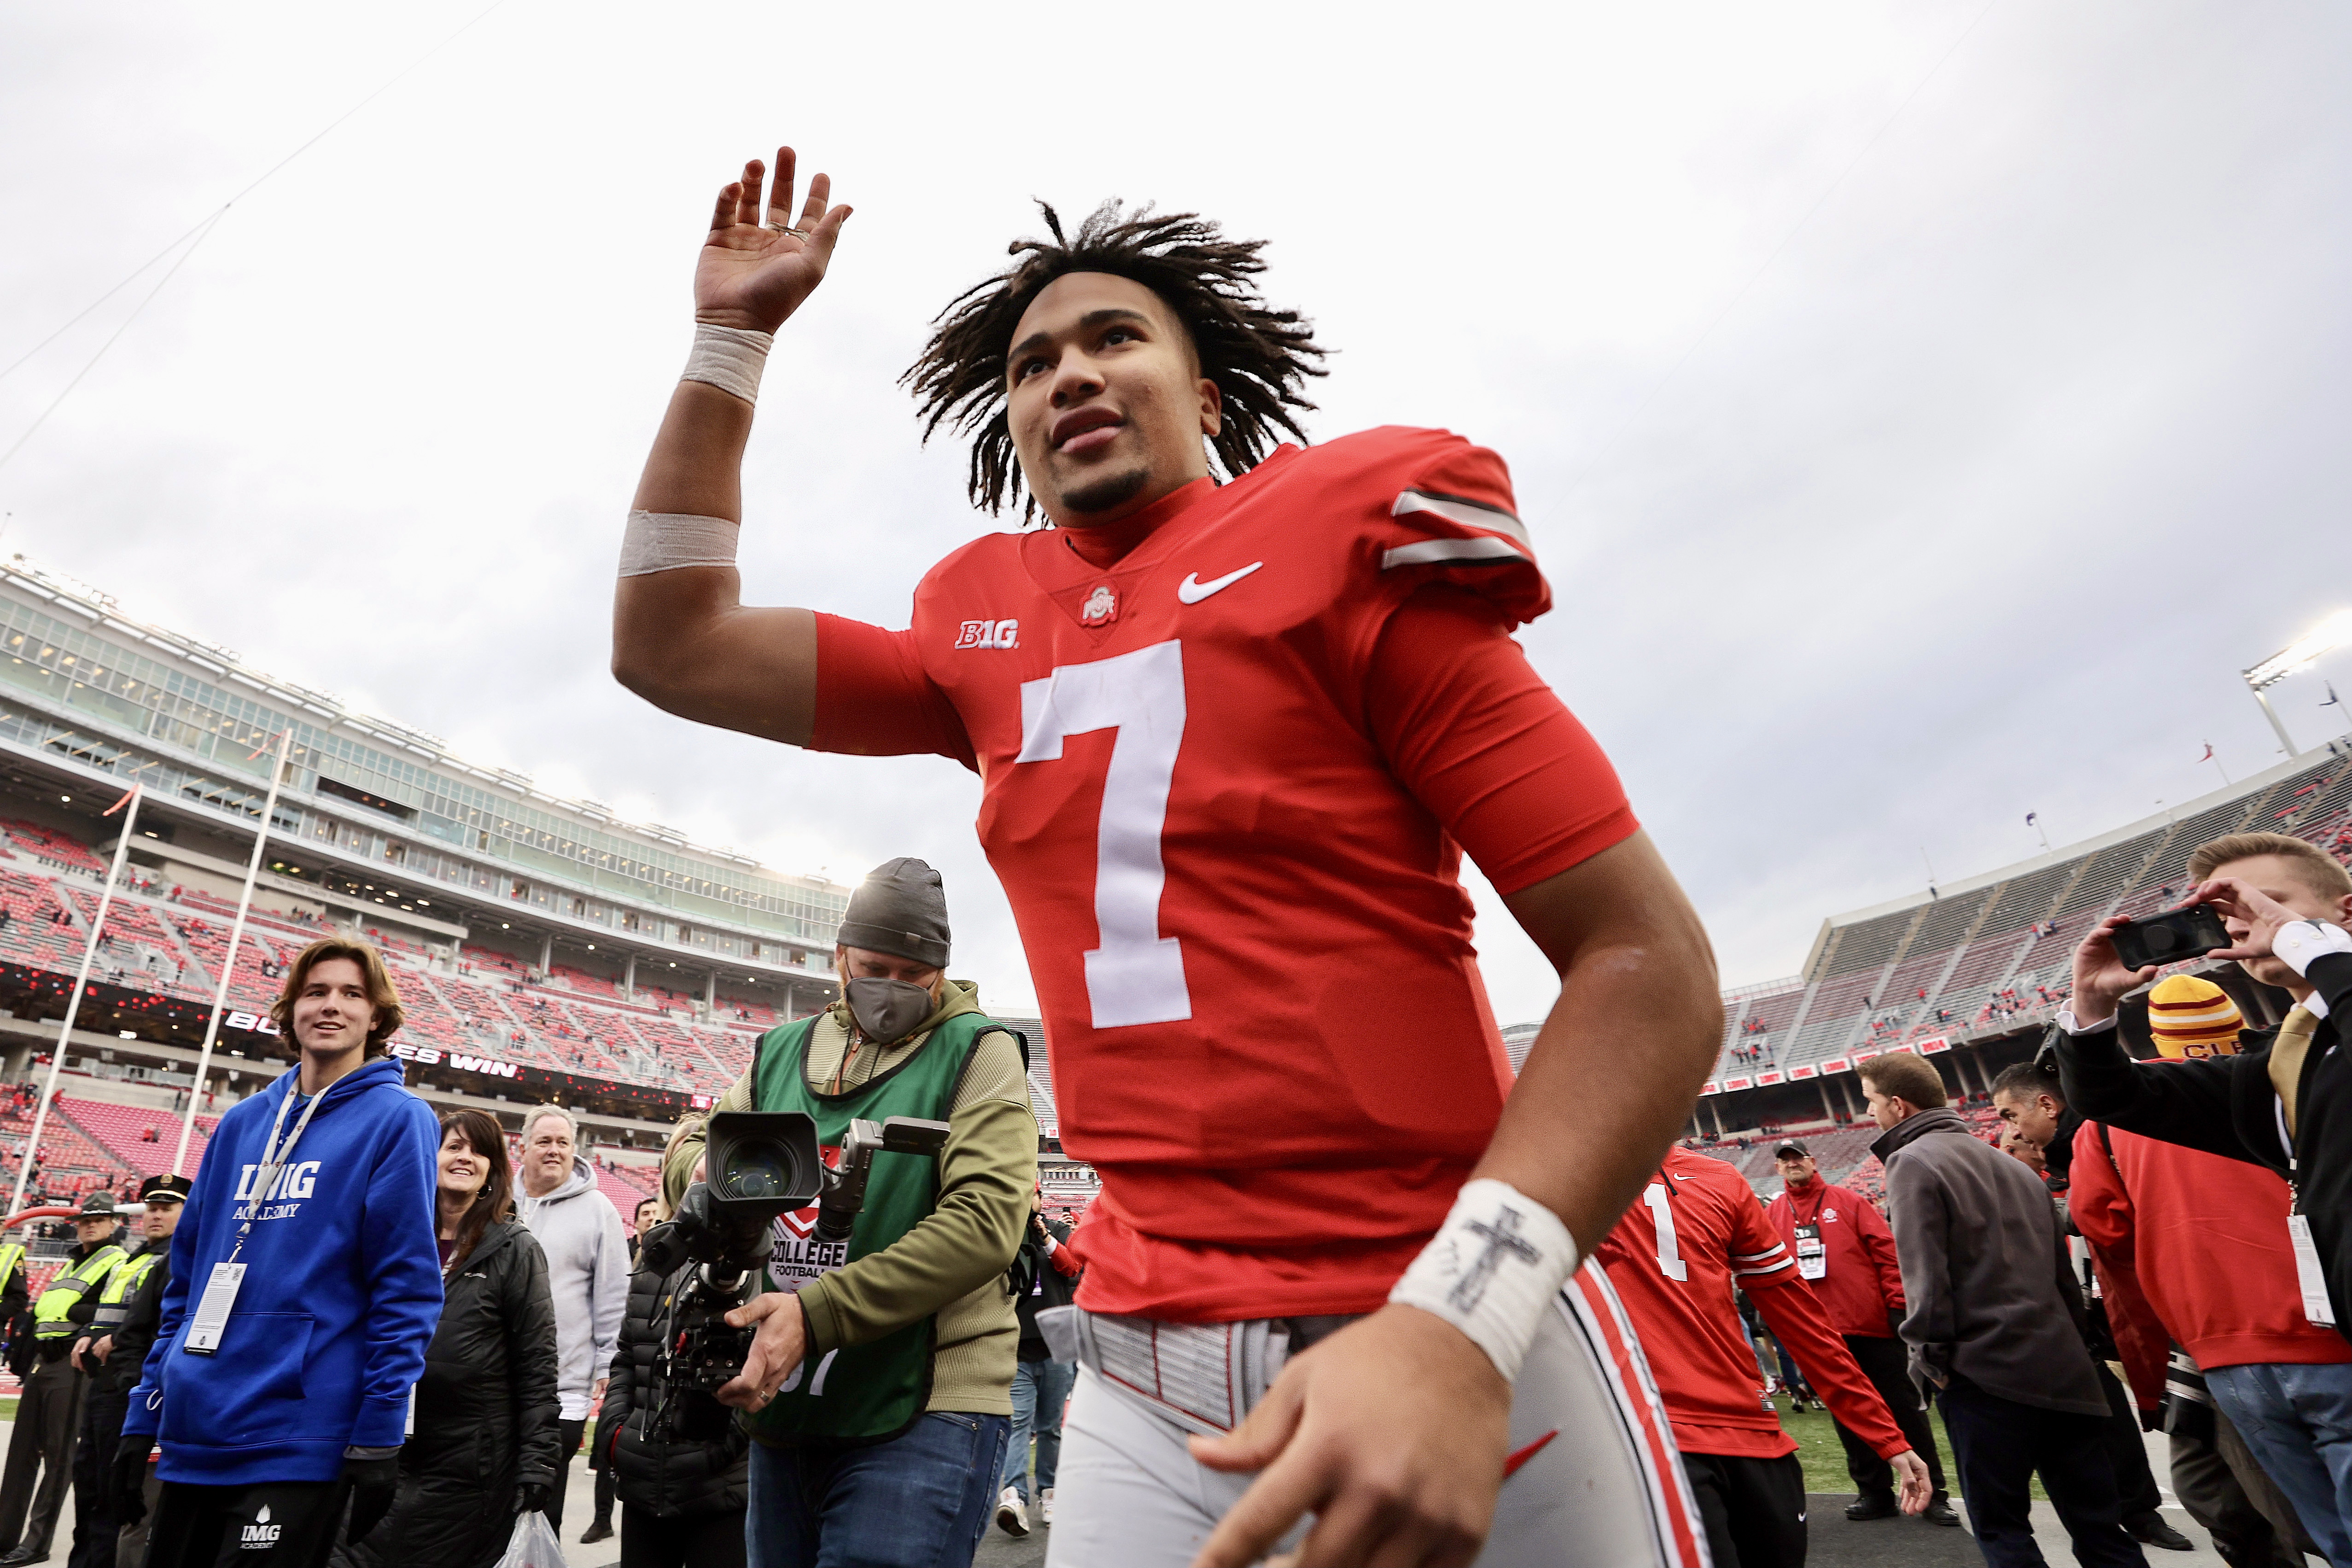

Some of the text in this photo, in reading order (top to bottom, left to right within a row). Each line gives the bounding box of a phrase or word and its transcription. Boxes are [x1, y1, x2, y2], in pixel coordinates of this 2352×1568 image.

[1016, 639, 1192, 1029] 7
[449, 1053, 518, 1078] WIN
[1643, 1183, 1688, 1282] 1
[240, 1524, 282, 1541] IMG
